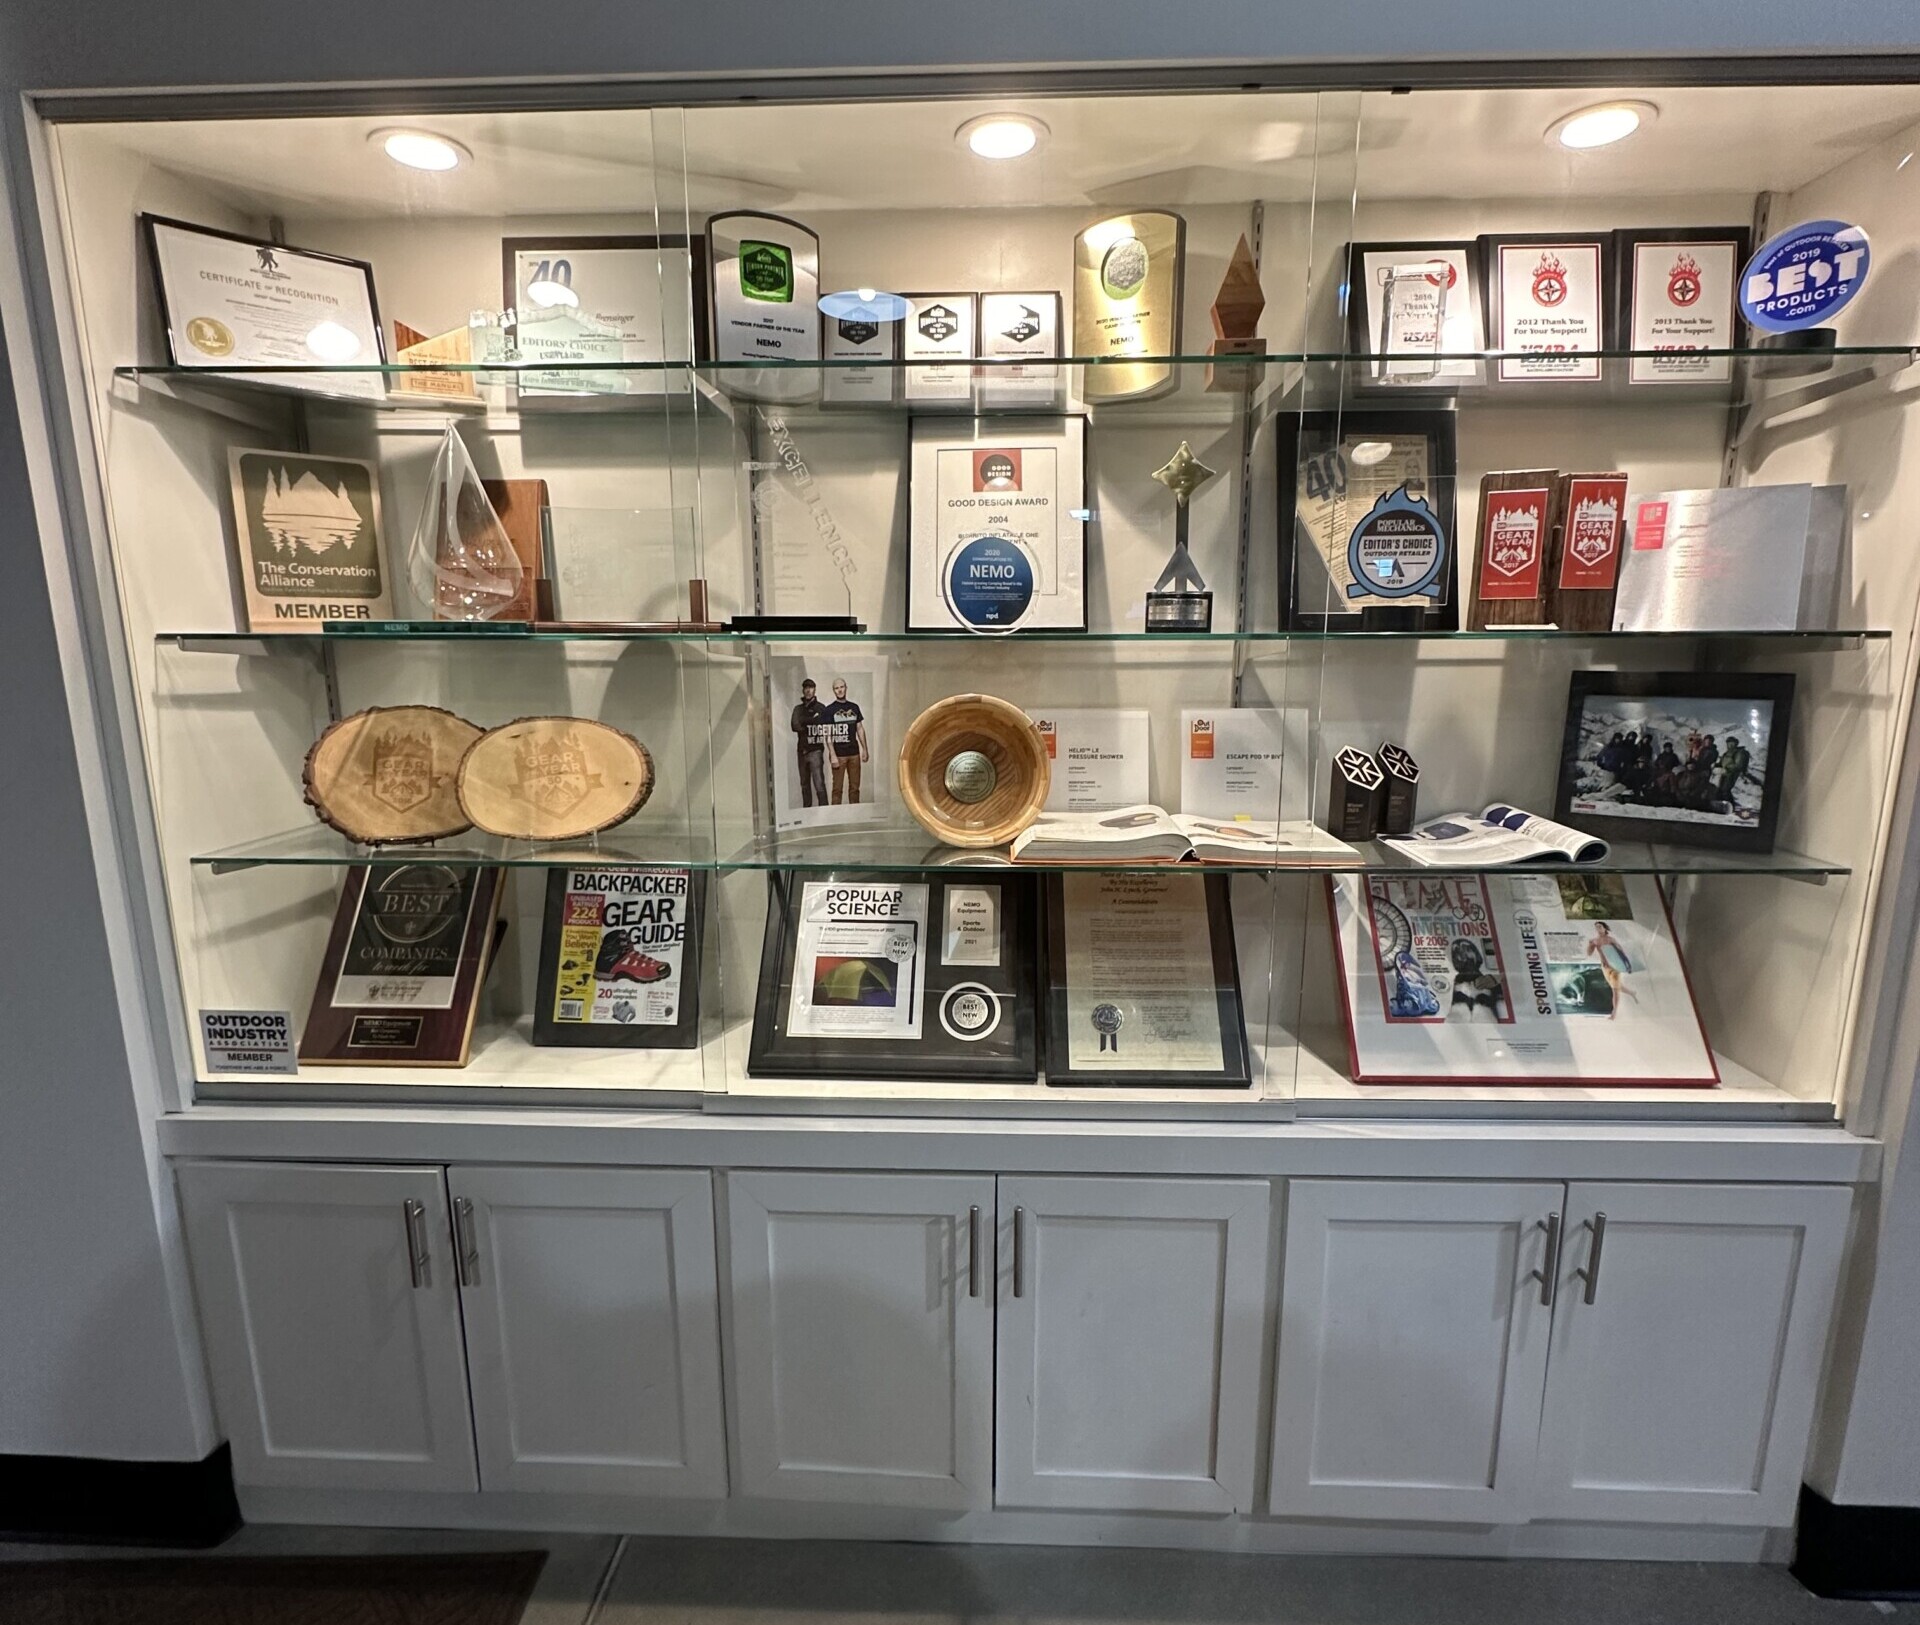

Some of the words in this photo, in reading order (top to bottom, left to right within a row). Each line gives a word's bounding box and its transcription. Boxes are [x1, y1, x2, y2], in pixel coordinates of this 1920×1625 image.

[1784, 235, 1821, 252] OUTDOOR
[1792, 248, 1821, 262] 2019
[1747, 248, 1866, 304] BEST
[199, 270, 261, 290] CERTIFICATE
[275, 286, 339, 306] RECOGNITION
[1756, 283, 1849, 314] PRODUCTS
[1785, 304, 1816, 317] .com
[1517, 318, 1538, 326] 2012
[1540, 318, 1568, 326] Thank
[1569, 318, 1584, 326] You
[1514, 327, 1528, 335] For
[1530, 327, 1549, 335] Your
[1550, 327, 1588, 337] Support!
[1651, 327, 1665, 335] For
[1665, 327, 1682, 335] Your
[1683, 327, 1715, 336] Support!
[756, 338, 782, 348] NEMO
[1110, 336, 1134, 346] NEMO
[948, 499, 976, 508] GOOD
[978, 498, 1013, 507] DESIGN
[1014, 498, 1049, 506] AWARD
[988, 516, 1009, 524] 2004
[1377, 519, 1416, 527] POPULAR
[1579, 521, 1610, 530] GEAR
[1377, 524, 1426, 532] MECHANICS
[1586, 529, 1611, 538] YEAR
[1497, 531, 1531, 540] GEAR
[1363, 539, 1400, 550] EDITOR'S
[1402, 538, 1433, 549] CHOICE
[1505, 538, 1532, 547] YEAR
[258, 561, 286, 573] The
[288, 562, 376, 577] Conservation
[969, 564, 1015, 579] NEMO
[260, 574, 315, 587] Alliance
[274, 603, 371, 619] MEMBER
[806, 723, 849, 736] TOGETHER
[808, 736, 816, 744] WE
[382, 760, 424, 769] GEAR
[525, 752, 575, 767] GEAR
[539, 762, 581, 775] YEAR
[573, 873, 686, 894] BACKPACKER
[826, 890, 903, 903] POPULAR
[383, 894, 450, 913] BEST
[827, 903, 900, 916] SCIENCE
[571, 907, 598, 919] 224
[603, 898, 676, 928] GEAR
[628, 923, 685, 944] GUIDE
[1412, 921, 1489, 937] INVENTIONS
[1414, 936, 1425, 945] OF
[1427, 936, 1450, 947] 2005
[1521, 926, 1538, 950] LIFE
[565, 940, 597, 949] Believe
[360, 947, 448, 960] COMPANIES
[1526, 952, 1552, 1015] SPORTING
[598, 988, 613, 999] 20
[205, 1015, 285, 1027] OUTDOOR
[207, 1028, 287, 1040] INDUSTRY
[227, 1053, 273, 1061] MEMBER
